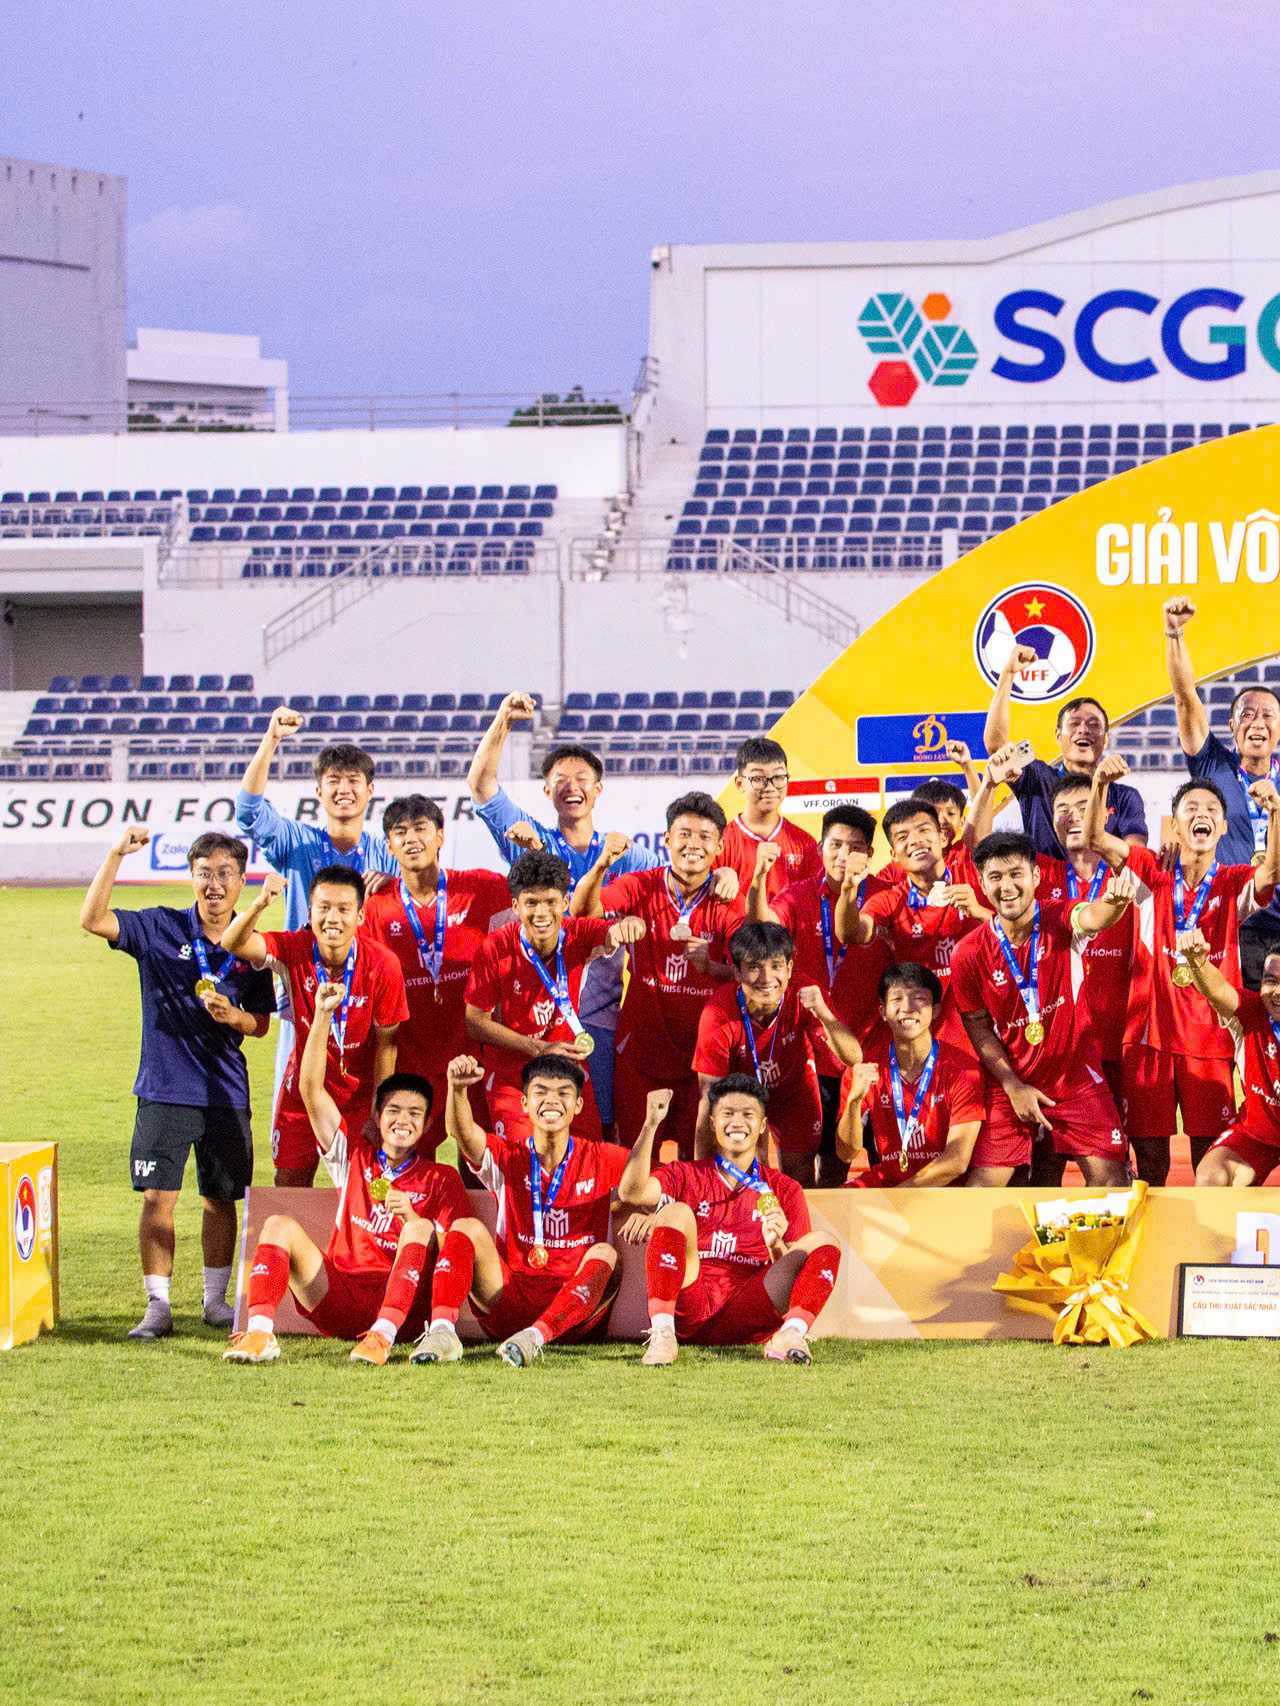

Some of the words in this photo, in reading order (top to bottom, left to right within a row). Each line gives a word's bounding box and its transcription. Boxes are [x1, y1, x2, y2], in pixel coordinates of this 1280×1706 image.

[1096, 506, 1198, 586] GIẢI
[1209, 508, 1280, 585] VÔ
[1020, 669, 1049, 682] VFF
[803, 797, 859, 809] VFF.ORG.VN
[3, 798, 153, 828] SSION
[699, 1250, 729, 1260] TERISE
[729, 1253, 761, 1267] HOMES
